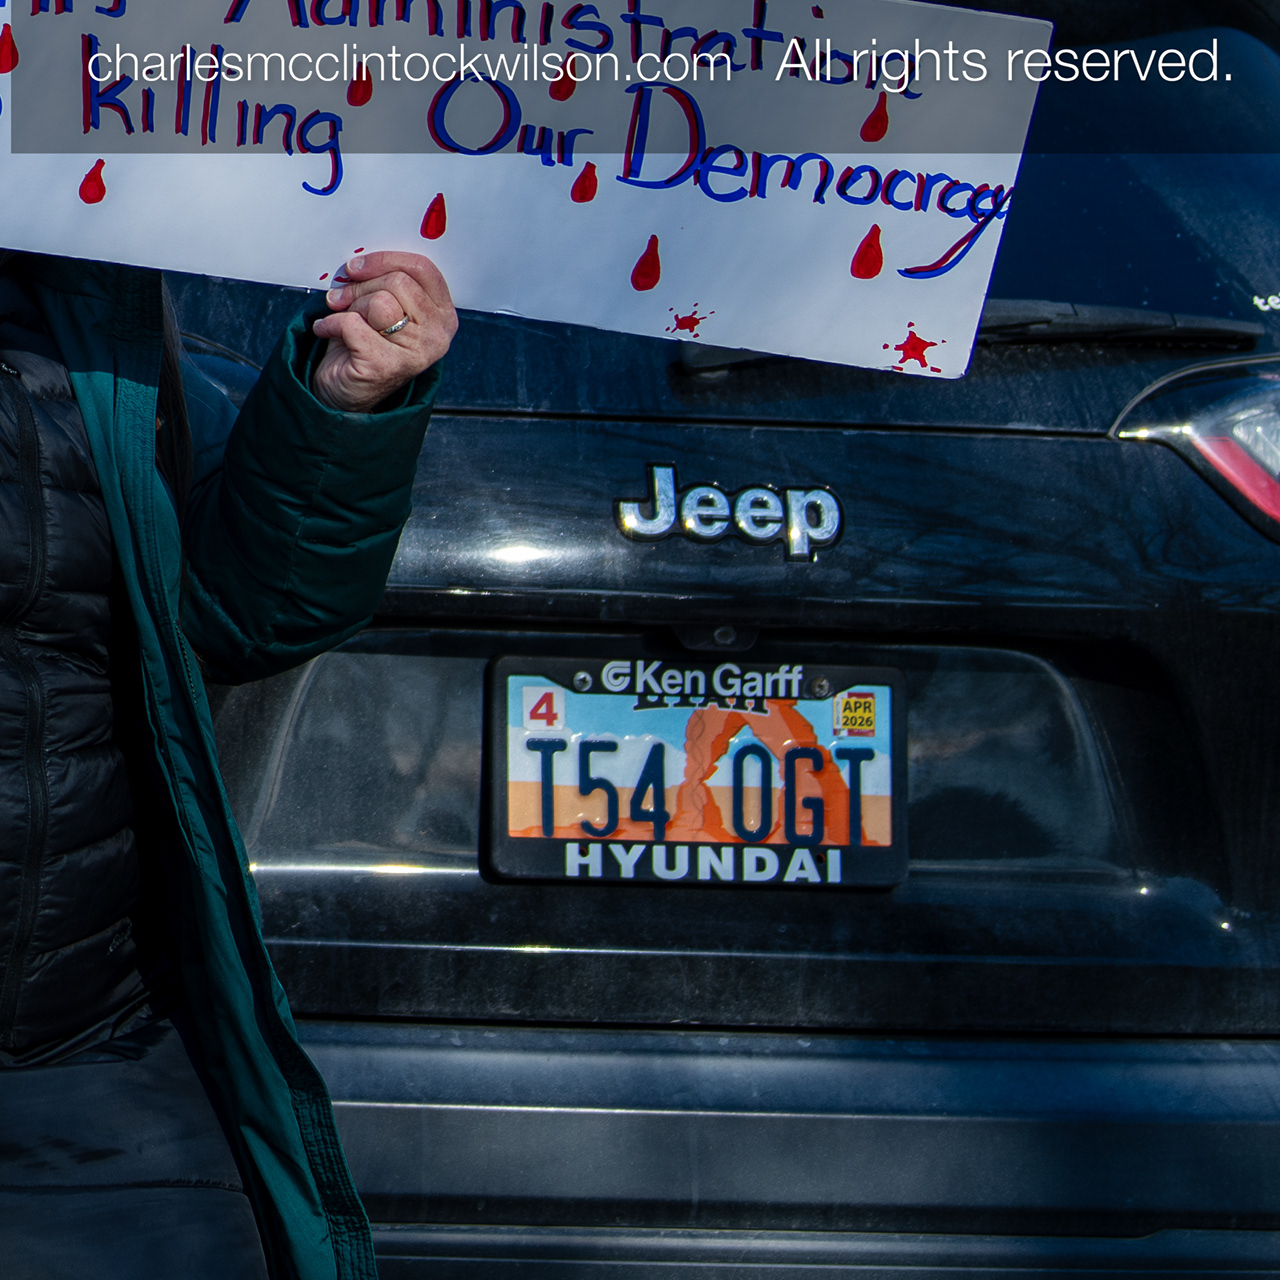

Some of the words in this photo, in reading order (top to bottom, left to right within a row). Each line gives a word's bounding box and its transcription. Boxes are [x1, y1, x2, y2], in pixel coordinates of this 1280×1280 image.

[80, 33, 344, 196] killing
[427, 74, 595, 167] Our
[614, 80, 1016, 280] Democracy
[618, 464, 841, 558] Jeep
[636, 660, 705, 694] Ken
[712, 663, 803, 699] Garff
[530, 693, 557, 726] 4
[843, 701, 872, 713] APR
[843, 716, 873, 727] 2026
[526, 738, 670, 841] T54
[566, 842, 841, 883] HYUNDAI
